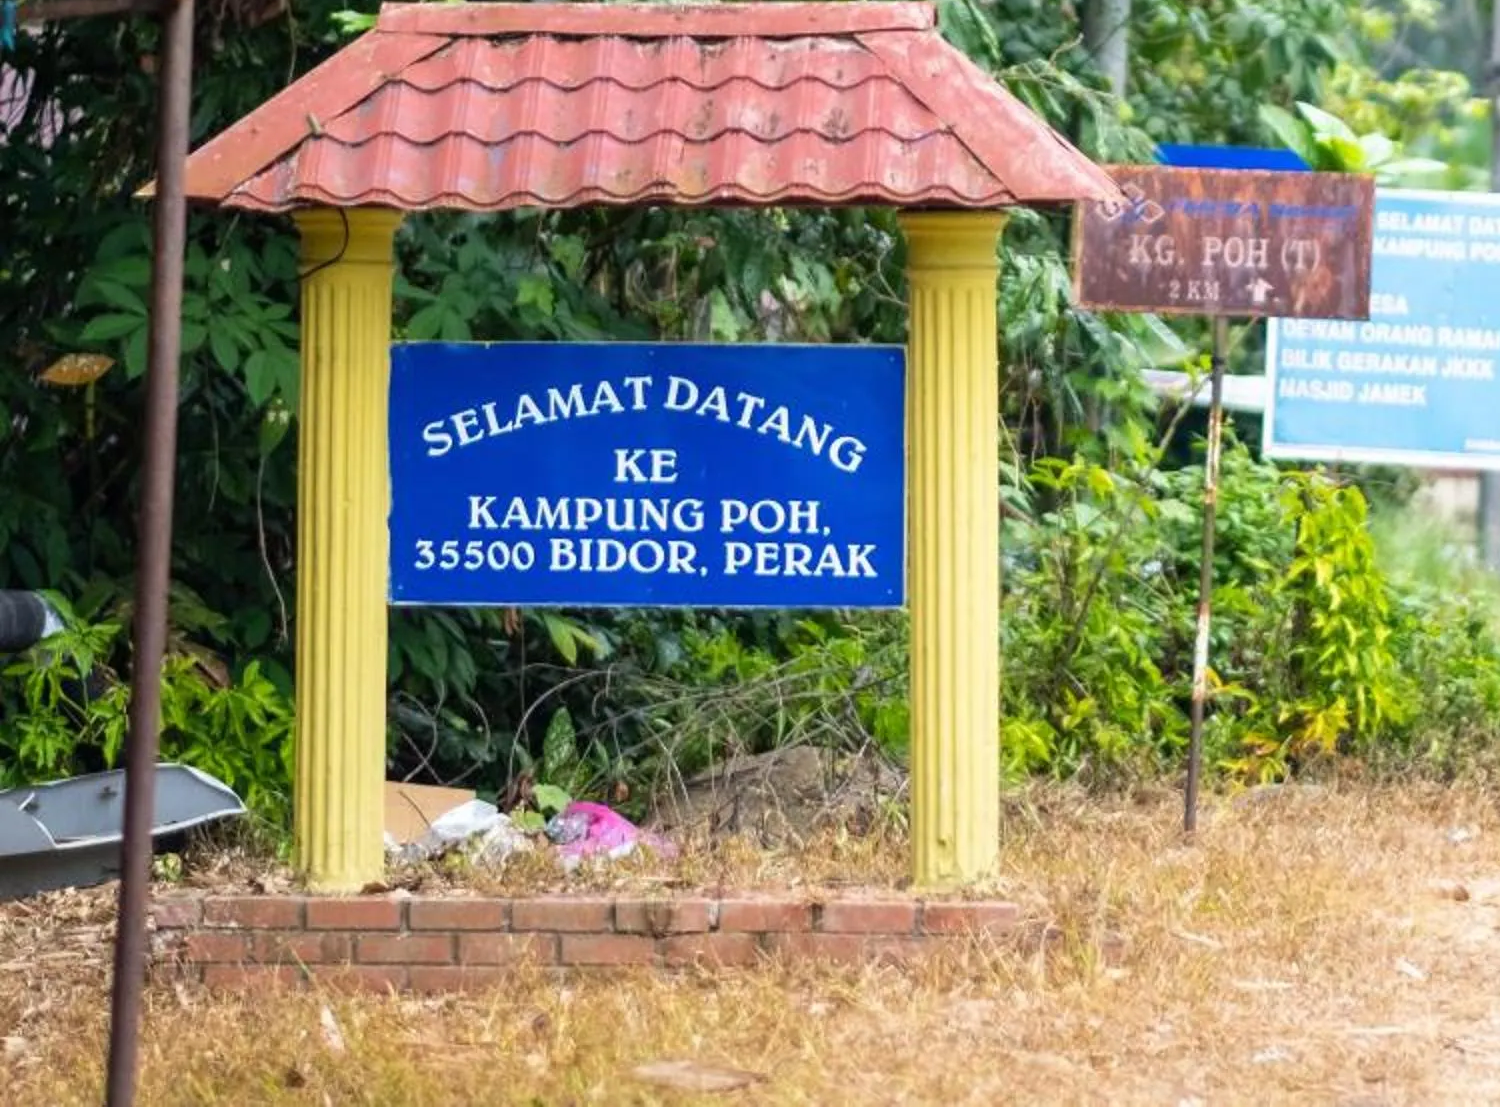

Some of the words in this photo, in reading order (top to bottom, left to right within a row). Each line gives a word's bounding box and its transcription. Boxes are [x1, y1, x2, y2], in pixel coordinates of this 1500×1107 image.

[1376, 210, 1465, 234] SELAMAT
[1128, 234, 1185, 266] KG.
[1201, 236, 1270, 269] POH
[1280, 237, 1321, 276] (T)
[1373, 236, 1466, 262] KAMPUNG
[1169, 279, 1181, 301] 2
[1186, 280, 1221, 302] KM
[1369, 292, 1409, 315] ESA
[1282, 319, 1356, 341] DEWAN
[1361, 323, 1434, 347] ORANG
[1281, 348, 1333, 371] BILIK
[1336, 350, 1437, 377] GERAKAN
[1441, 357, 1496, 381] JKKK
[1279, 378, 1355, 402] MASJID
[1357, 382, 1428, 406] JAMEK
[421, 375, 653, 458] SELAMAT
[662, 375, 867, 474] DATANG
[614, 449, 678, 484] KE
[468, 495, 705, 533] KAMPUNG
[719, 499, 831, 537] POH,
[414, 538, 535, 573] 35500
[549, 538, 709, 578] BIDOR,
[723, 541, 879, 578] PERAK
